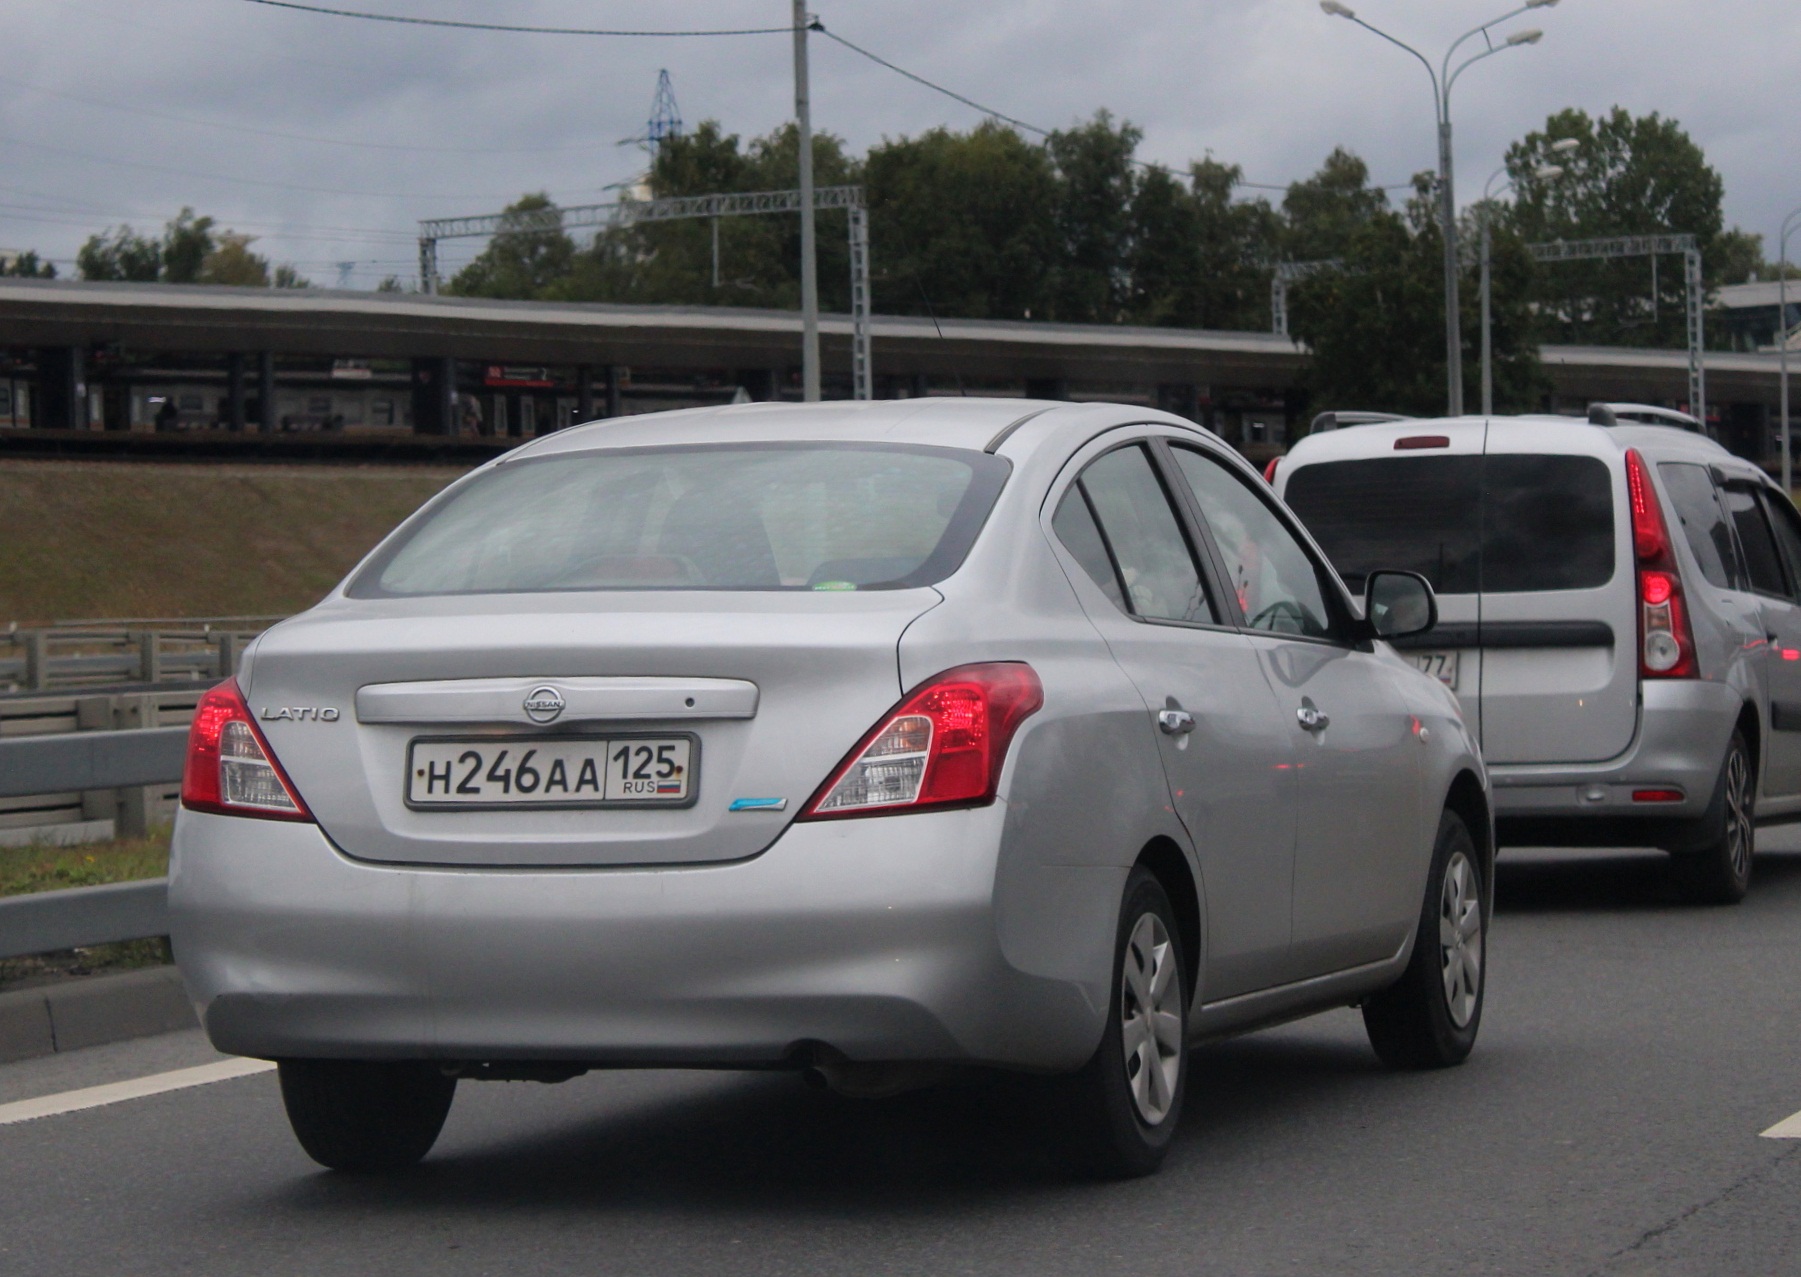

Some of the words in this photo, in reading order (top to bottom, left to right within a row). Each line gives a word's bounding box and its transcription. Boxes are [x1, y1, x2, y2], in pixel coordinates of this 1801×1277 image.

[1422, 655, 1447, 675] 77
[526, 700, 561, 708] NISSAN
[260, 707, 340, 723] LATIO
[613, 745, 676, 780] 125
[623, 781, 656, 793] RUS
